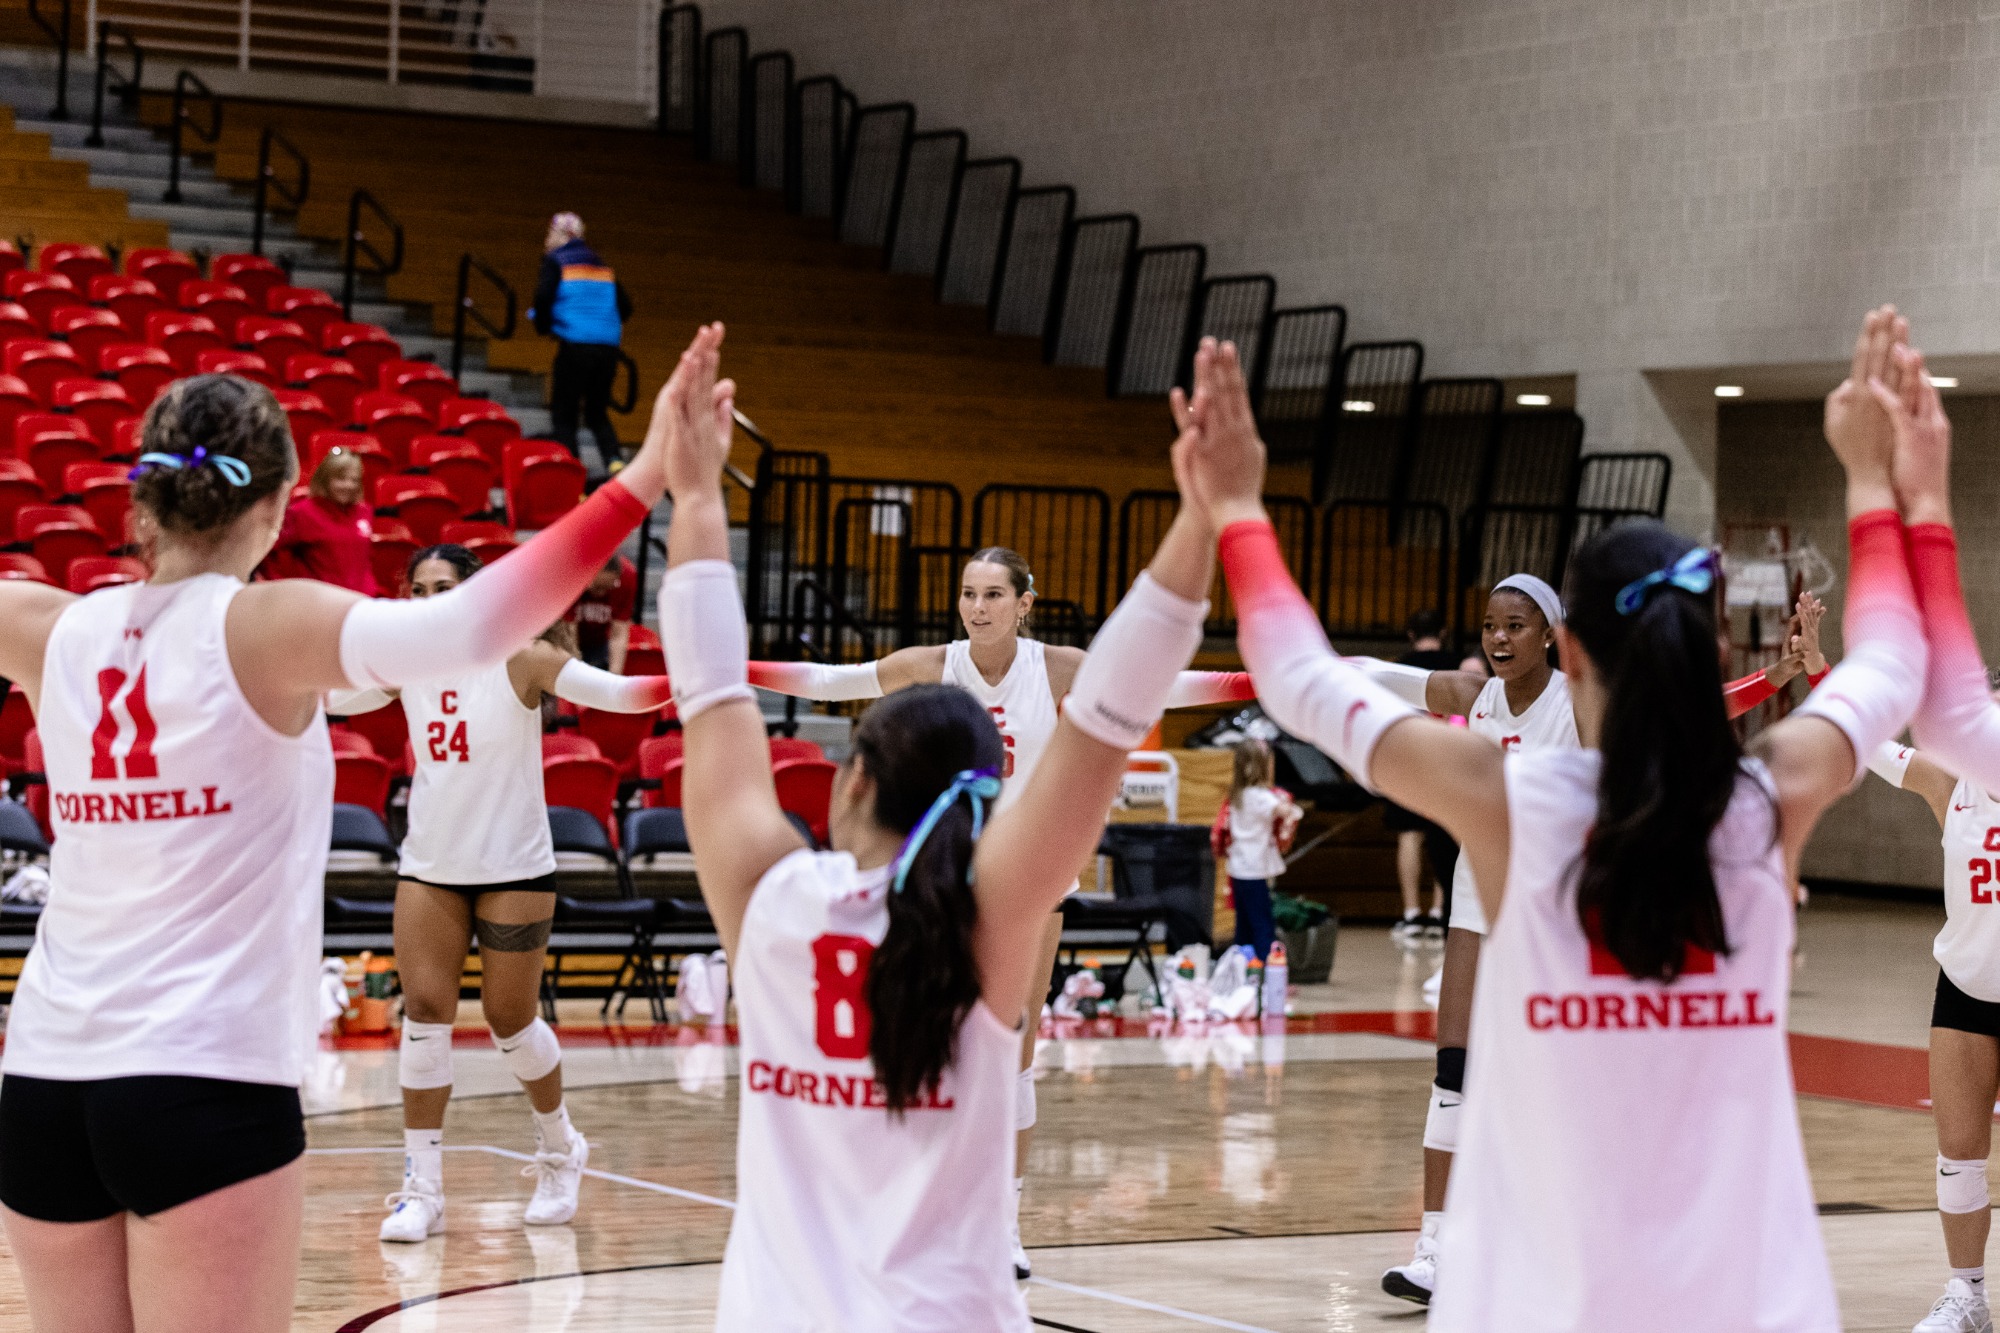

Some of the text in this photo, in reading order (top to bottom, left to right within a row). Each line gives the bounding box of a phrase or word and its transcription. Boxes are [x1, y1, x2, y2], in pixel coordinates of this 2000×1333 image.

[91, 661, 159, 781] 11
[440, 690, 458, 715] C
[427, 720, 470, 762] 24
[55, 785, 233, 824] CORNELL
[1968, 857, 2000, 905] 2
[811, 932, 878, 1061] 8
[1525, 989, 1775, 1032] CORNELL
[748, 1061, 955, 1111] CORNEL
